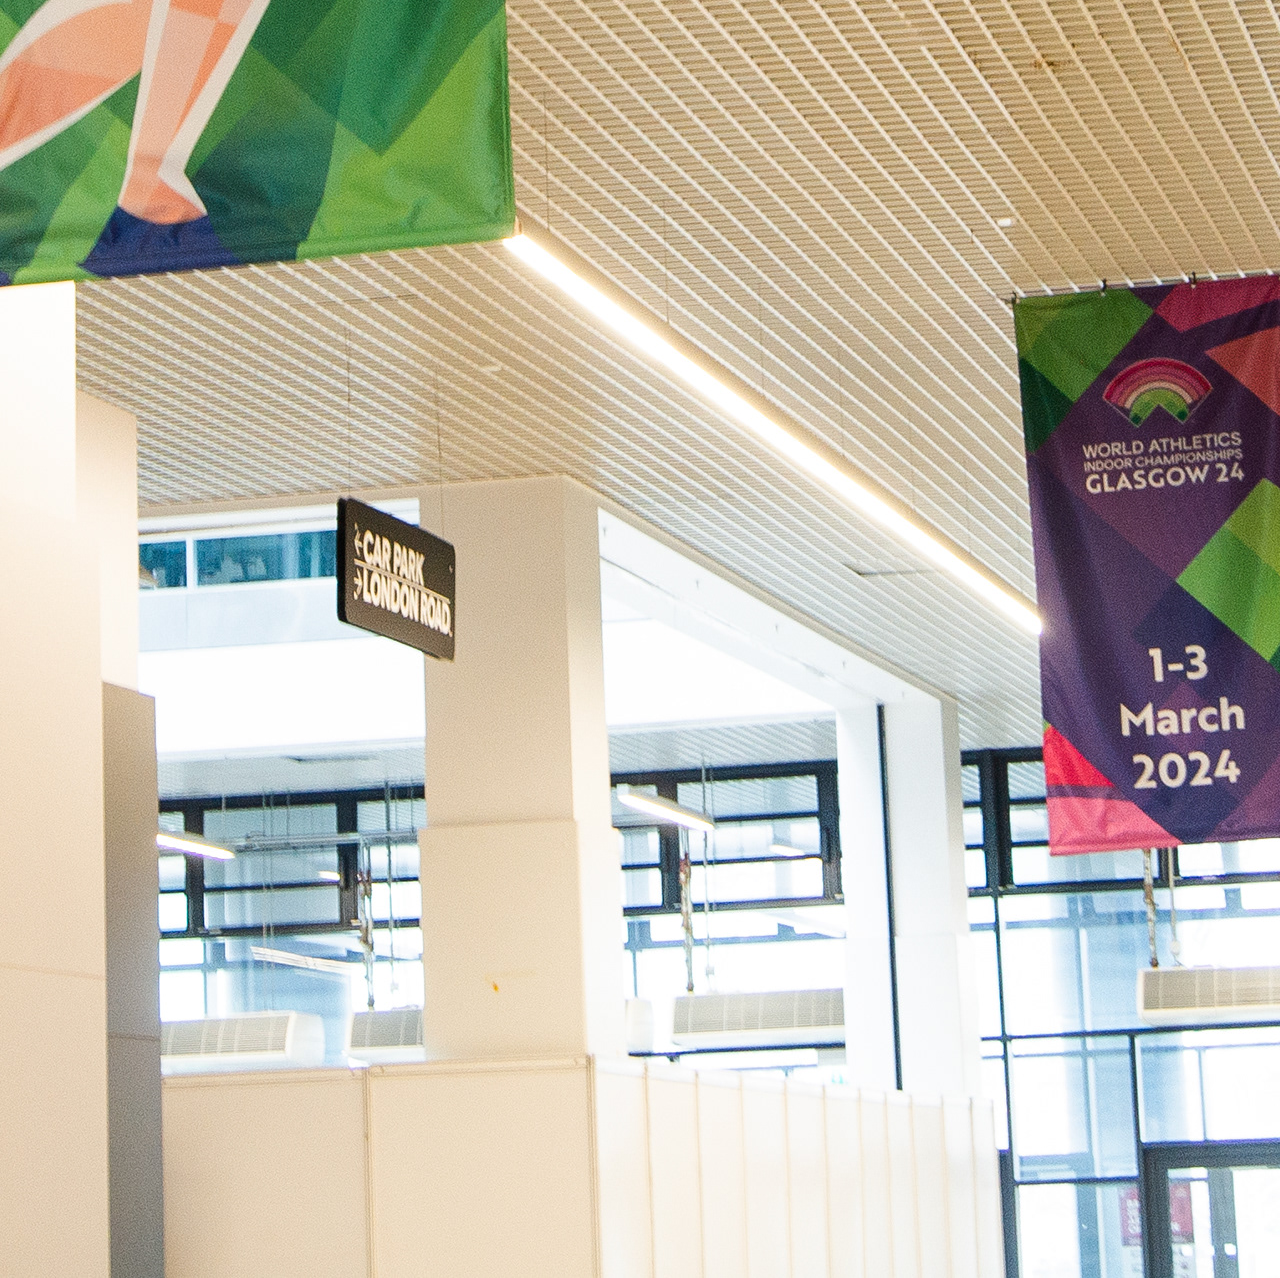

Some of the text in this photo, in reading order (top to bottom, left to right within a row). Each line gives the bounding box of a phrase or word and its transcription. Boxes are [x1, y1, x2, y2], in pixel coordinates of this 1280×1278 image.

[1082, 431, 1243, 460] WORLD ATHLETICS
[1083, 448, 1244, 472] INDOOR CHAMPIONSHIPS
[1085, 461, 1245, 494] GLASGOW 24
[363, 529, 426, 588] CAR PARK
[363, 567, 452, 636] LONDON ROAD
[1147, 643, 1209, 683] 1-3
[1120, 695, 1246, 737] March
[1132, 748, 1242, 789] 2024
